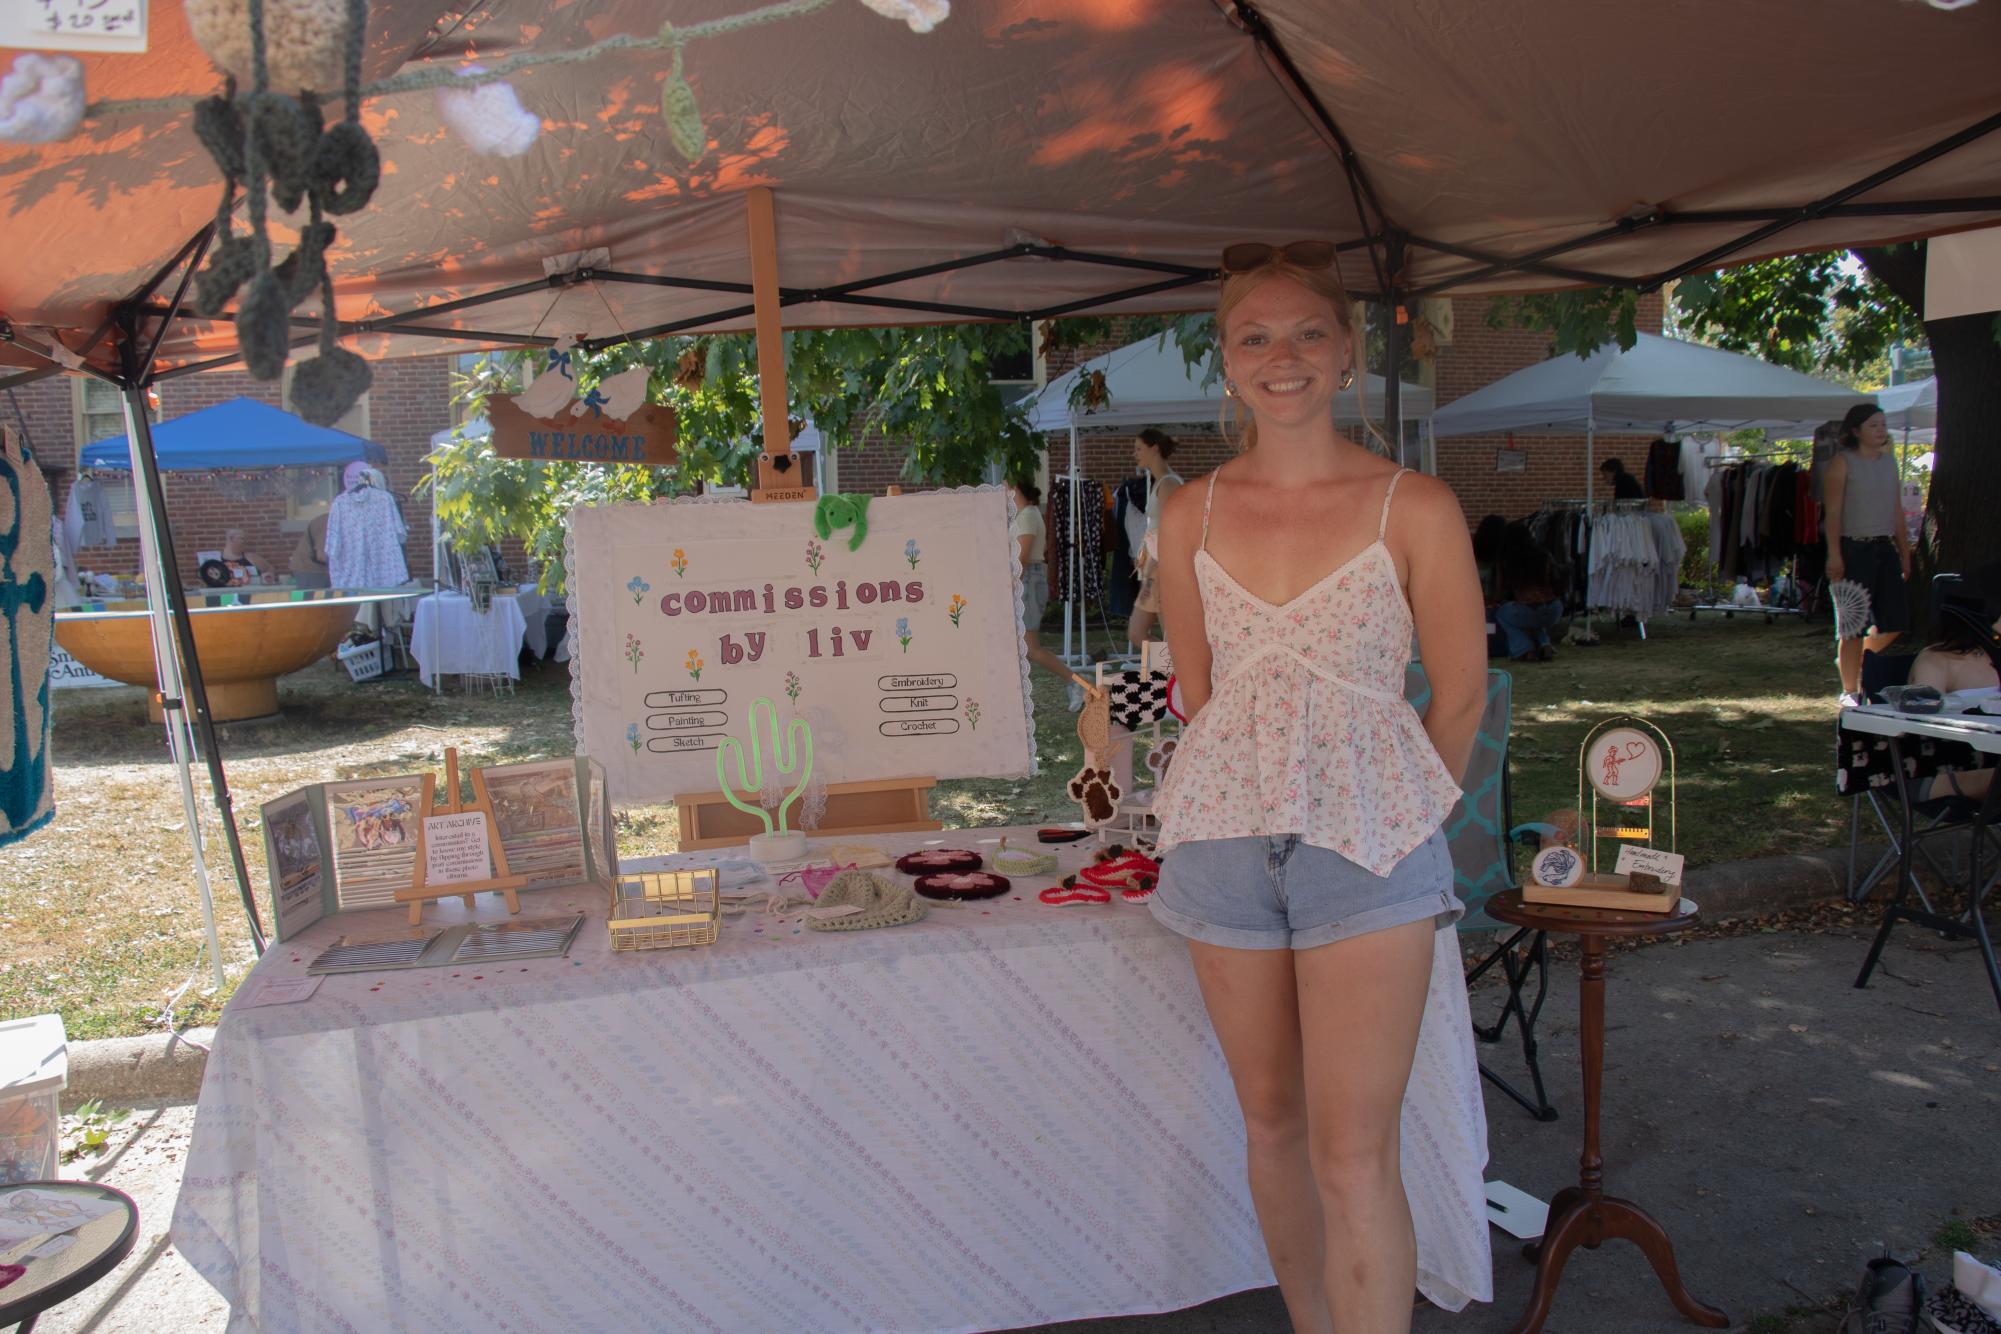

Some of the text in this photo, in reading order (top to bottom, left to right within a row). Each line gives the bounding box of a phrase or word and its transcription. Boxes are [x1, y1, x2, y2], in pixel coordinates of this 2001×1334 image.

[528, 431, 647, 461] WELCOME
[765, 491, 804, 500] MEEDEN
[660, 580, 925, 617] commissions
[719, 626, 873, 665] by liv
[890, 677, 944, 689] Embroidery
[668, 692, 702, 704] Tufting
[910, 697, 929, 708] Knit
[668, 716, 705, 727] Painting
[900, 721, 937, 731] Crochet
[673, 737, 704, 747] Sketch
[428, 821, 445, 831] ART
